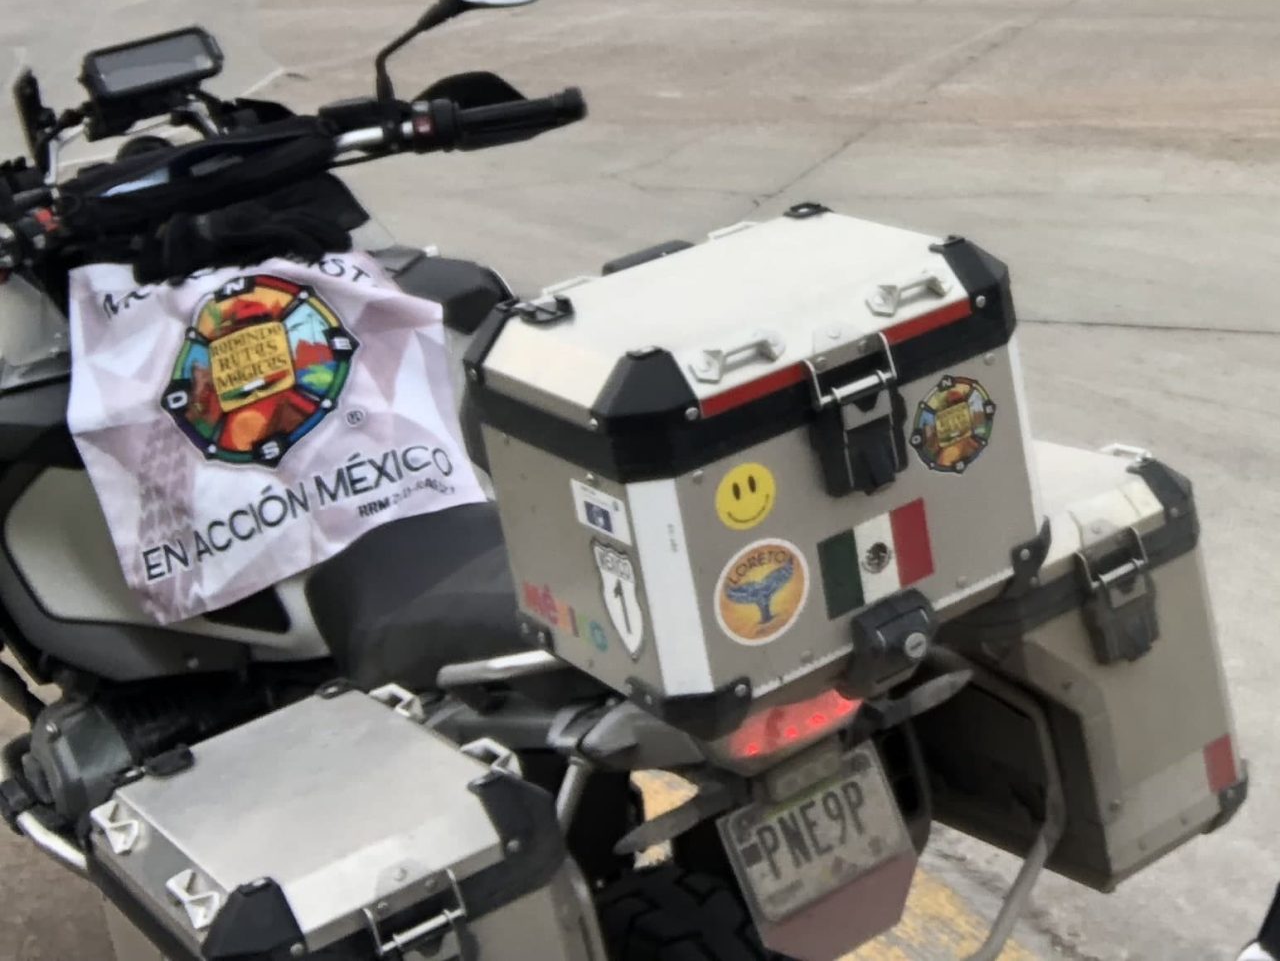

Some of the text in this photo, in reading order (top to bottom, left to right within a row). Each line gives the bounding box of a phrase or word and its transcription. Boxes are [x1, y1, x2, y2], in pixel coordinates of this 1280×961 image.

[142, 544, 190, 582] EN
[195, 485, 311, 559] ACCIÓN
[313, 445, 453, 506] MÉXICO
[728, 549, 787, 585] LORETO
[754, 781, 866, 881] PNE9P
